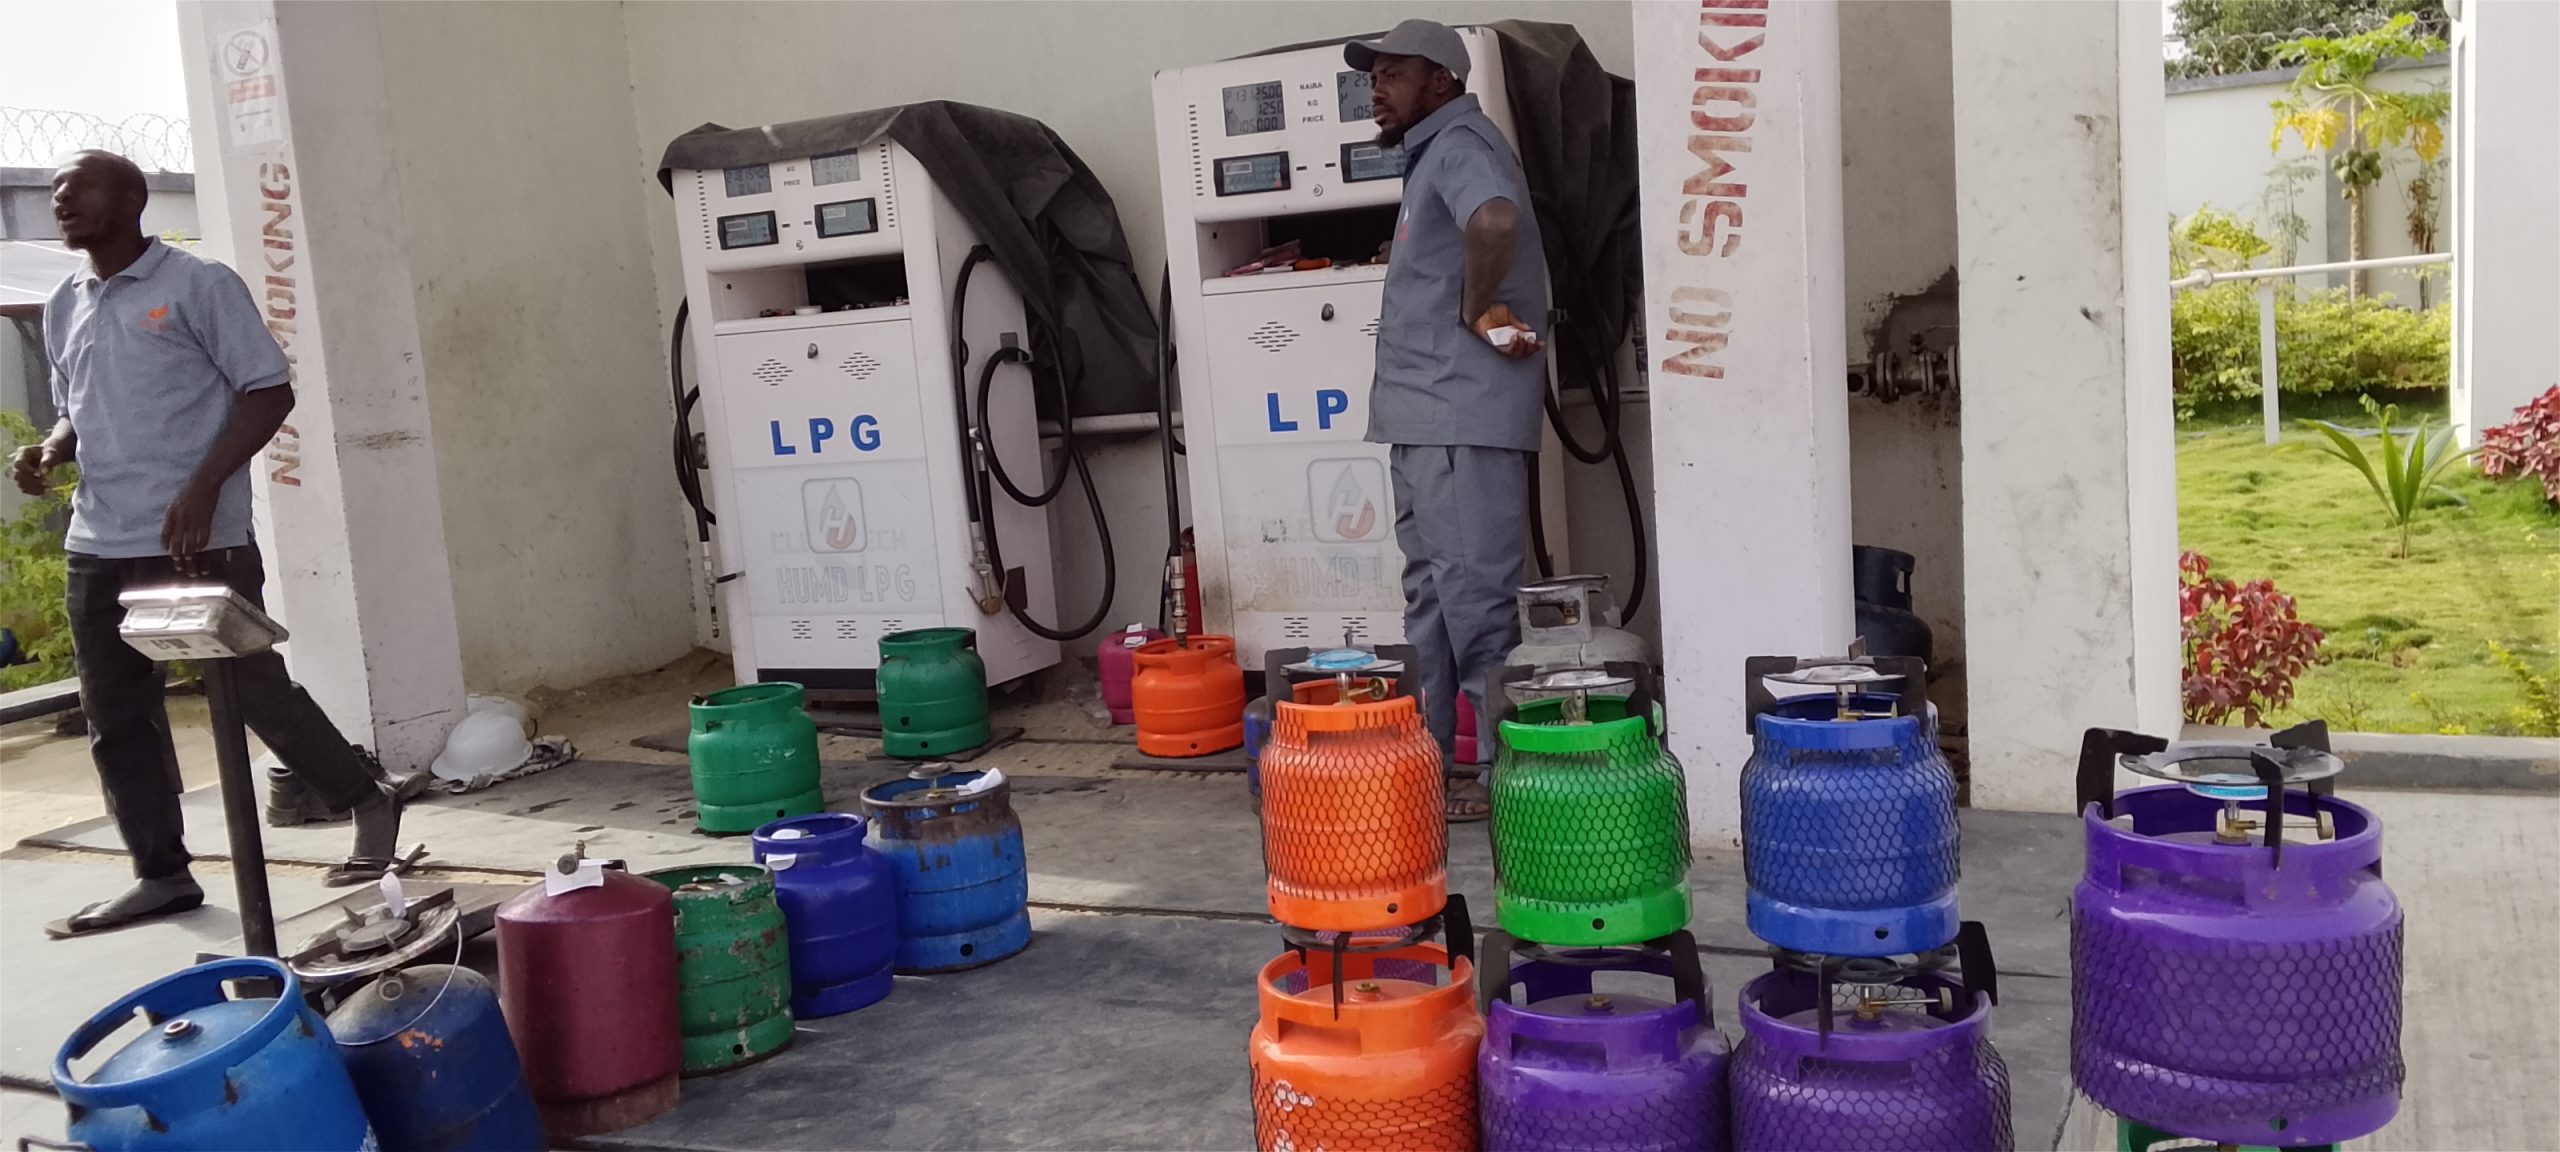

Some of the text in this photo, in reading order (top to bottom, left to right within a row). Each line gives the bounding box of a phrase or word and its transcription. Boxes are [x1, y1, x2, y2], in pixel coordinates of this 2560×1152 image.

[1302, 114, 1325, 124] PRICE
[259, 162, 298, 396] MOKING
[1661, 286, 1733, 379] NO
[1267, 389, 1349, 433] LP
[770, 414, 882, 456] LPG
[776, 563, 917, 604] HUMD LPG
